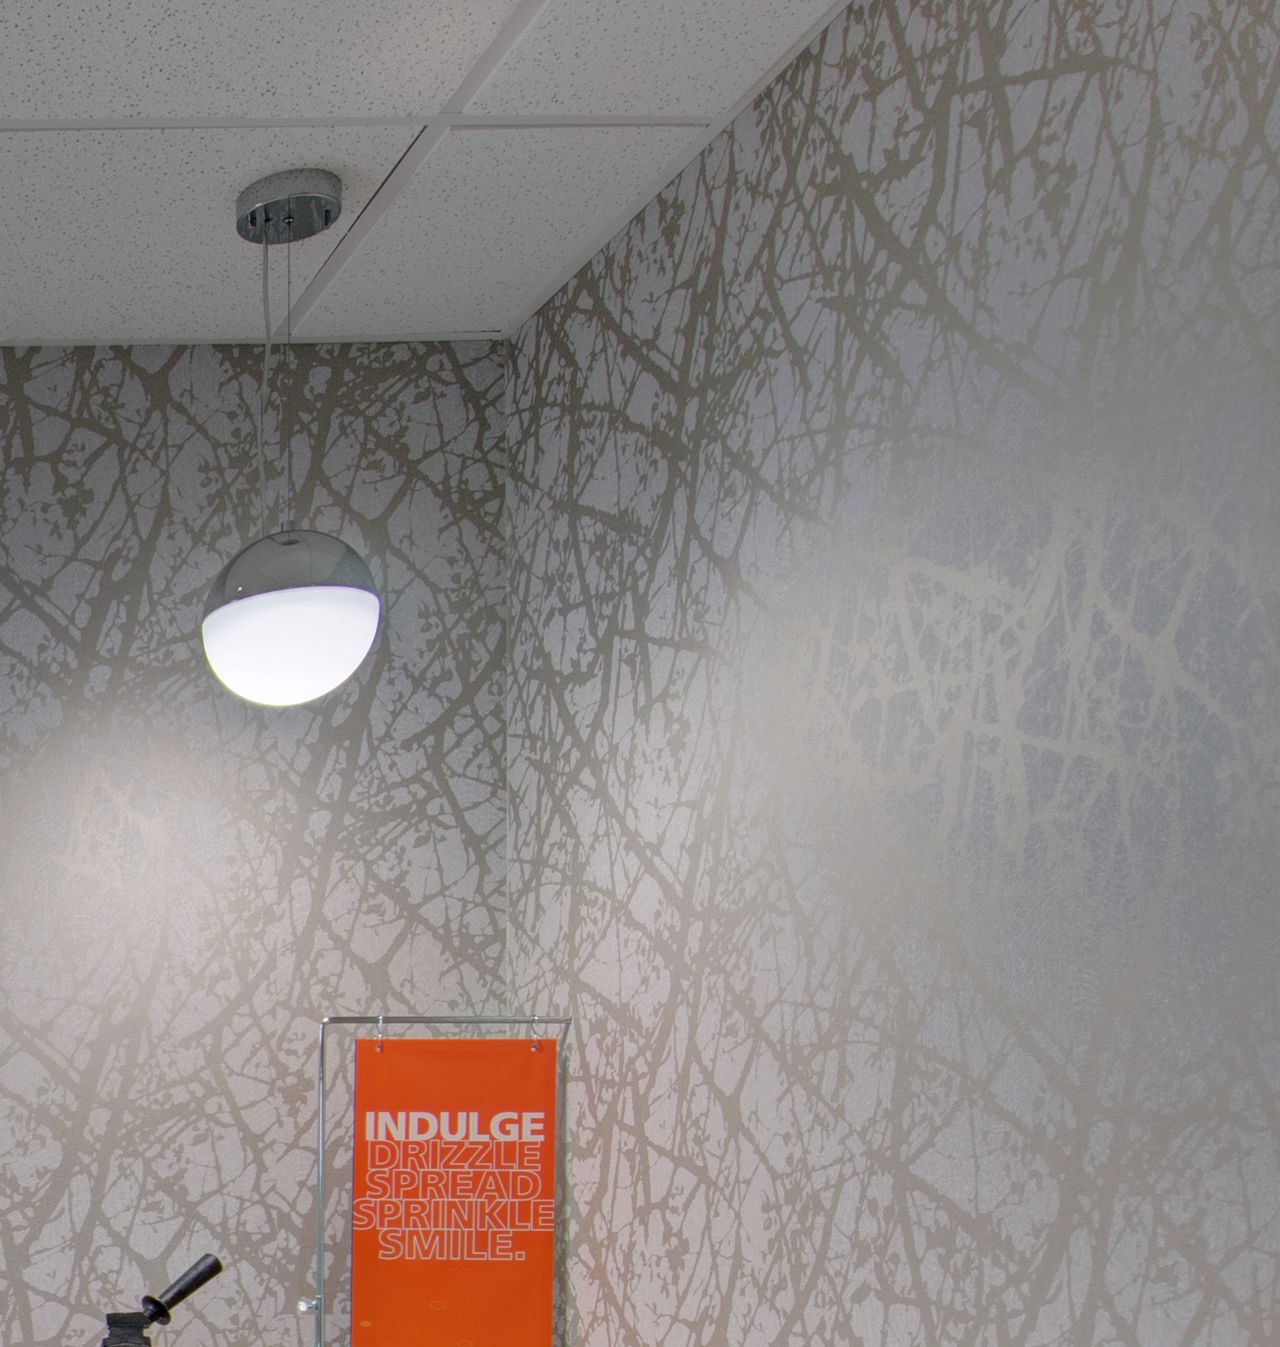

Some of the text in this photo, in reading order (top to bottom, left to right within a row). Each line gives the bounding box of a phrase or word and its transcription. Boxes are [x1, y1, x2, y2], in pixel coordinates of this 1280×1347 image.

[365, 1111, 545, 1142] INDULGE
[368, 1140, 541, 1171] DRIZZLE
[366, 1169, 542, 1200] SPREAD
[352, 1198, 555, 1231] SPRINKLE
[378, 1228, 526, 1261] SMILE.
